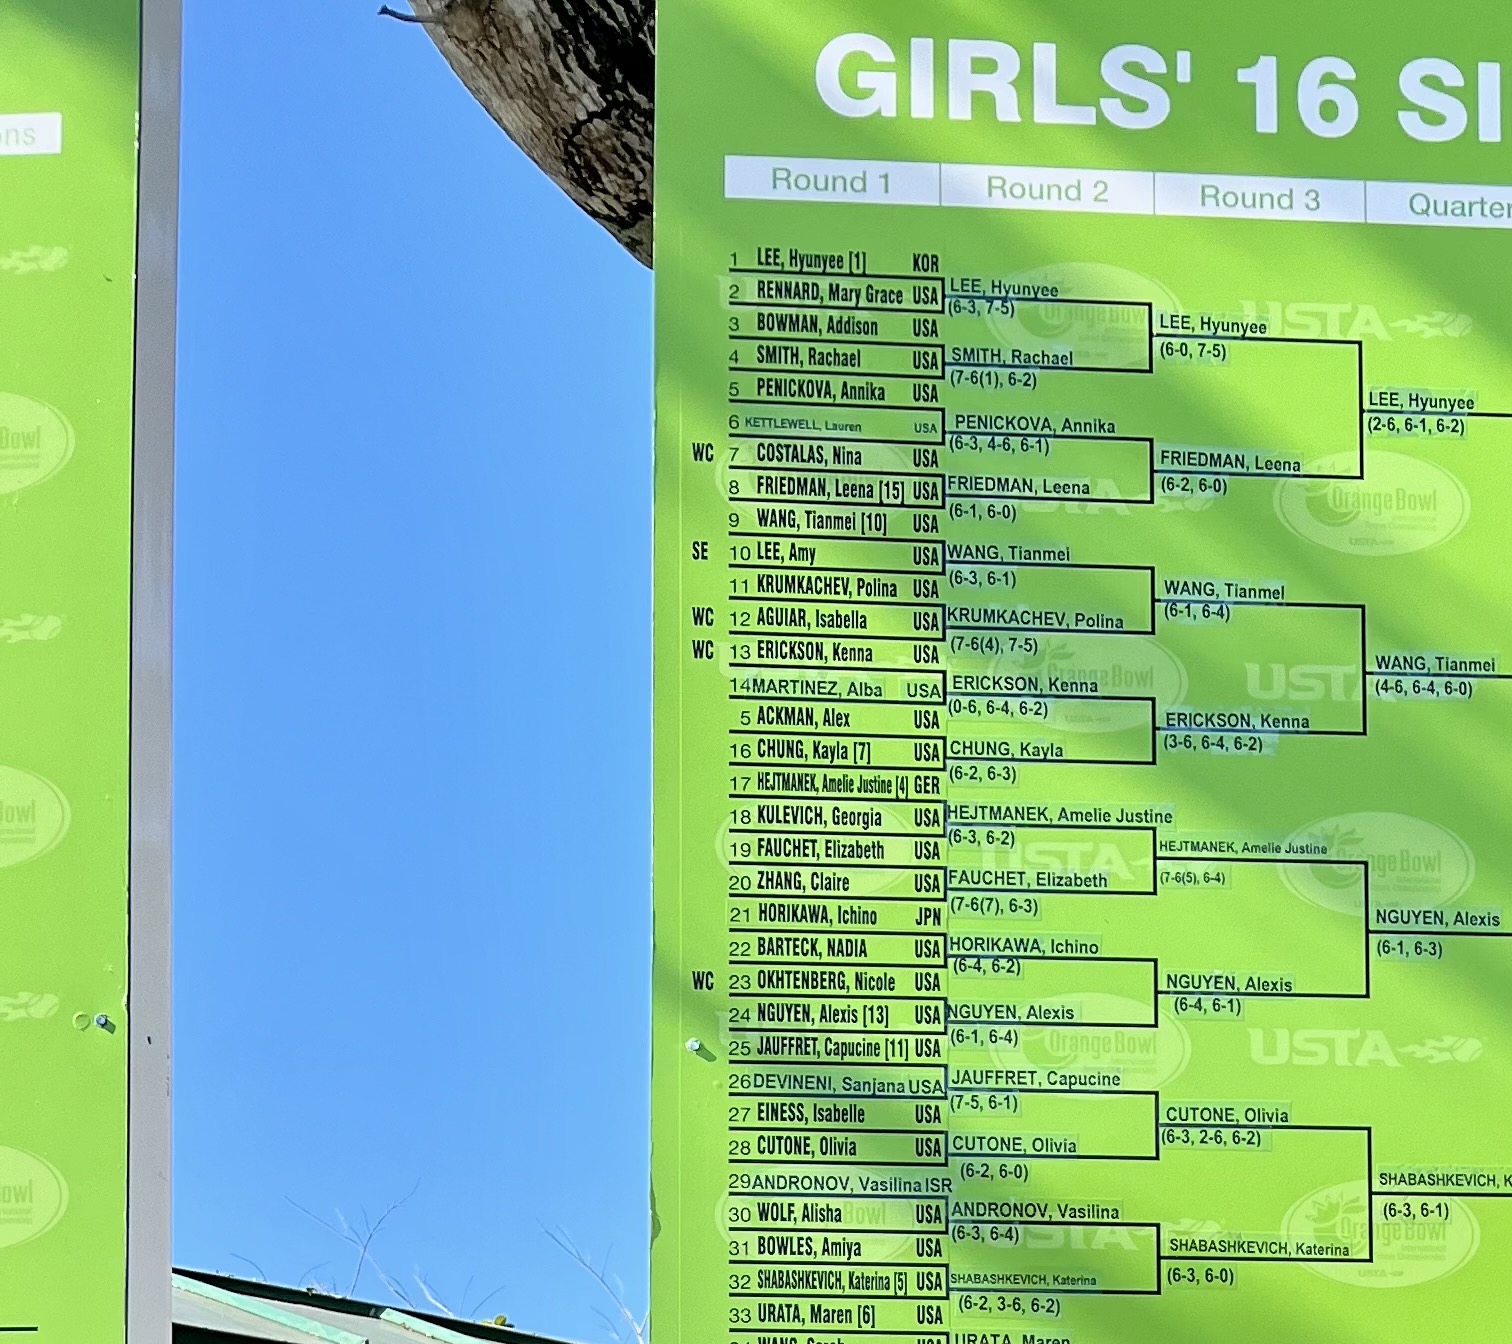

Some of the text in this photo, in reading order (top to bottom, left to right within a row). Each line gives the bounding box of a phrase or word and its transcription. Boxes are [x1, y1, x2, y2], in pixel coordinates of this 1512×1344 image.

[814, 32, 1192, 130] GIRLS'
[1236, 54, 1359, 138] 16
[772, 166, 890, 194] Round 1
[986, 176, 1109, 202] Round 2
[1200, 185, 1320, 211] Round 3
[730, 248, 939, 274] 1 LEE, Hyunyee [1] KOR
[729, 282, 939, 307] 2 RENNARD, Mary Grace USA
[729, 414, 937, 434] 6 KETTLEWELL, Lauren USA
[692, 442, 939, 468] WC 7 COSTALAS, Nina USA
[692, 541, 939, 566] SE 10 LEE, Amy USA
[947, 607, 1124, 629] KRUMKACHEV, Polina
[950, 635, 1038, 656] (7-6(4), 7-5)
[730, 773, 940, 798] 17 HEJTMANEK, Amelie Justine [4] GER
[730, 905, 941, 927] 21 HORIKAWA, Ichino JPN
[1248, 1027, 1402, 1068] USTA
[729, 1073, 943, 1095] 26 DEVINENI, Sanjana USA
[729, 1271, 942, 1296] 32 SHABASHKEVICH, Katerina [5] USA
